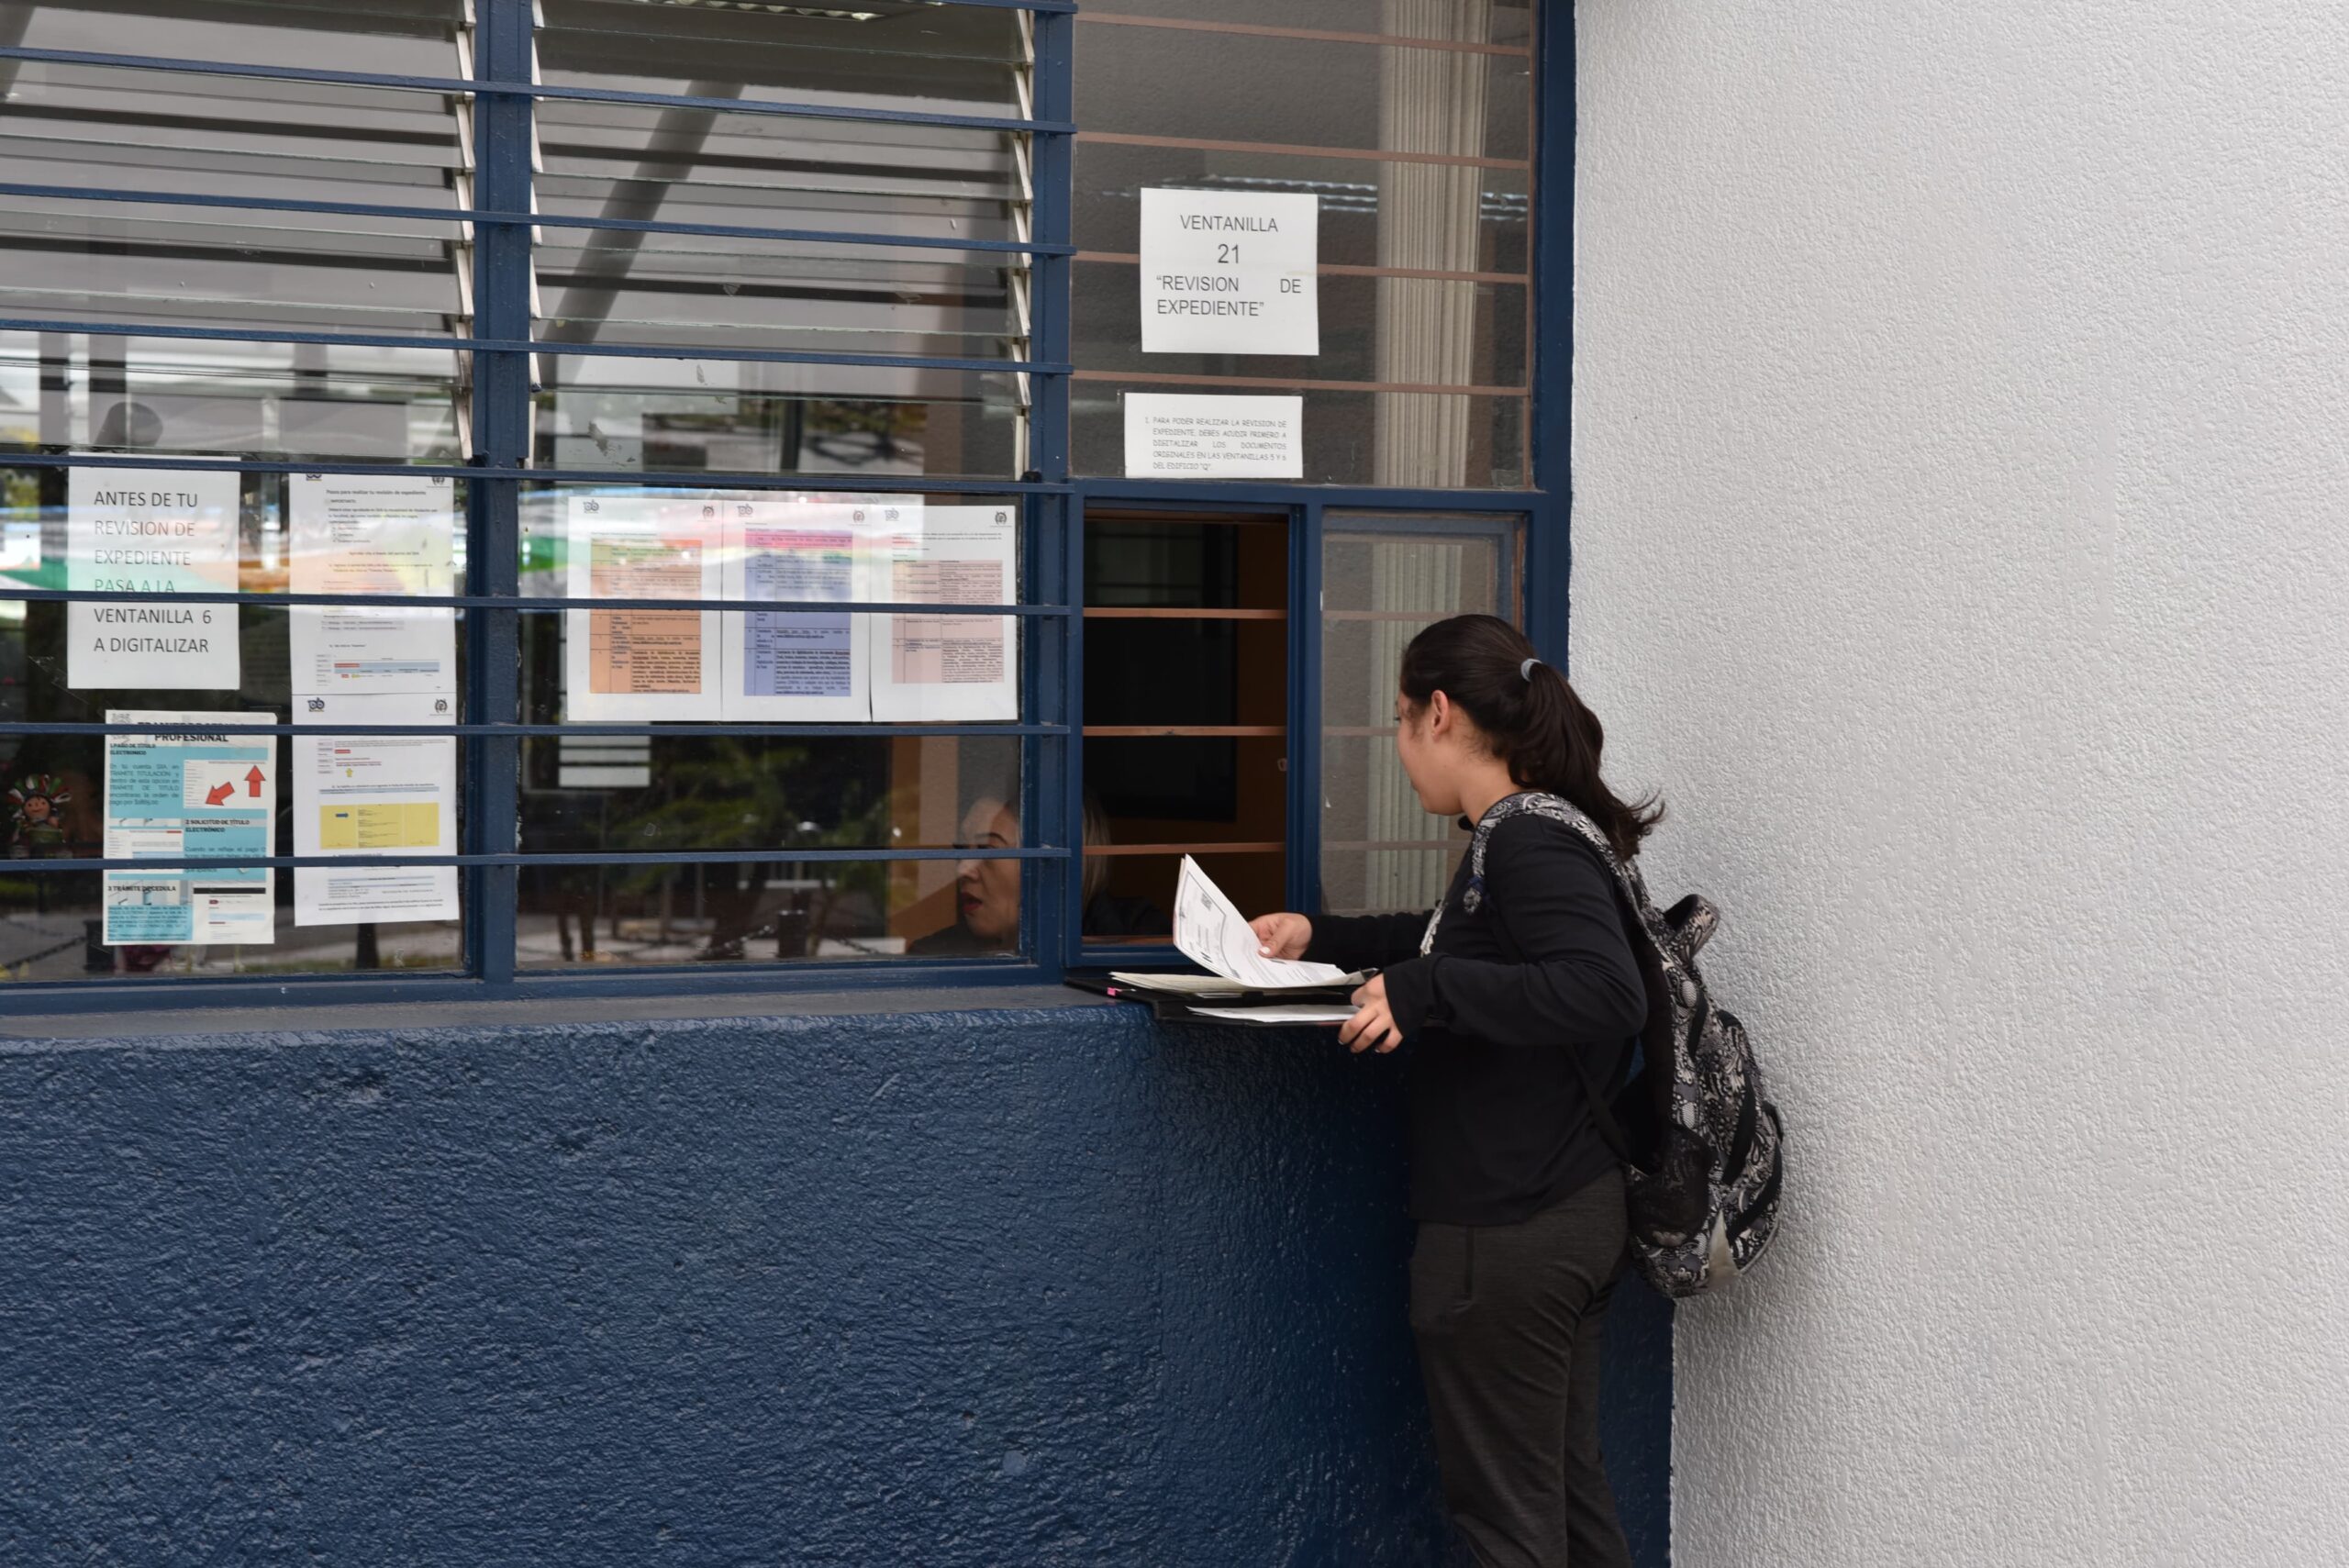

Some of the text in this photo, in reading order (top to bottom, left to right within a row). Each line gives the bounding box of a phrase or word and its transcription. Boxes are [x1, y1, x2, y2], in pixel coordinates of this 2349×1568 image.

[1180, 215, 1278, 232] VENTANILLA
[1218, 243, 1240, 264] 21
[1280, 278, 1301, 294] DE
[1172, 417, 1195, 426] PODER
[1196, 417, 1230, 427] REALIZAR
[1230, 418, 1240, 427] LA
[1277, 420, 1287, 428] DE
[1198, 429, 1220, 438] DEBES
[1222, 430, 1248, 439] ACUDIR
[1250, 430, 1279, 439] PRIMERO
[1152, 439, 1198, 448] DIGITALIZAR
[1241, 441, 1287, 450] DOCUMENTOS
[1152, 450, 1196, 459] ORIGINALES
[1197, 451, 1207, 460] EN
[1222, 452, 1269, 461] VENTANILLAS
[1152, 462, 1165, 470] DEL
[1166, 462, 1199, 470] EDIFICIO
[94, 491, 197, 507] ANTES DE TU
[95, 520, 195, 537] REVISION DE
[95, 550, 191, 566] EXPEDIENTE
[95, 579, 136, 593] PASA
[141, 580, 153, 593] A
[94, 608, 212, 624] VENTANILLA 6
[94, 638, 209, 653] A DIGITALIZAR
[154, 734, 229, 742] PROFESIONAL
